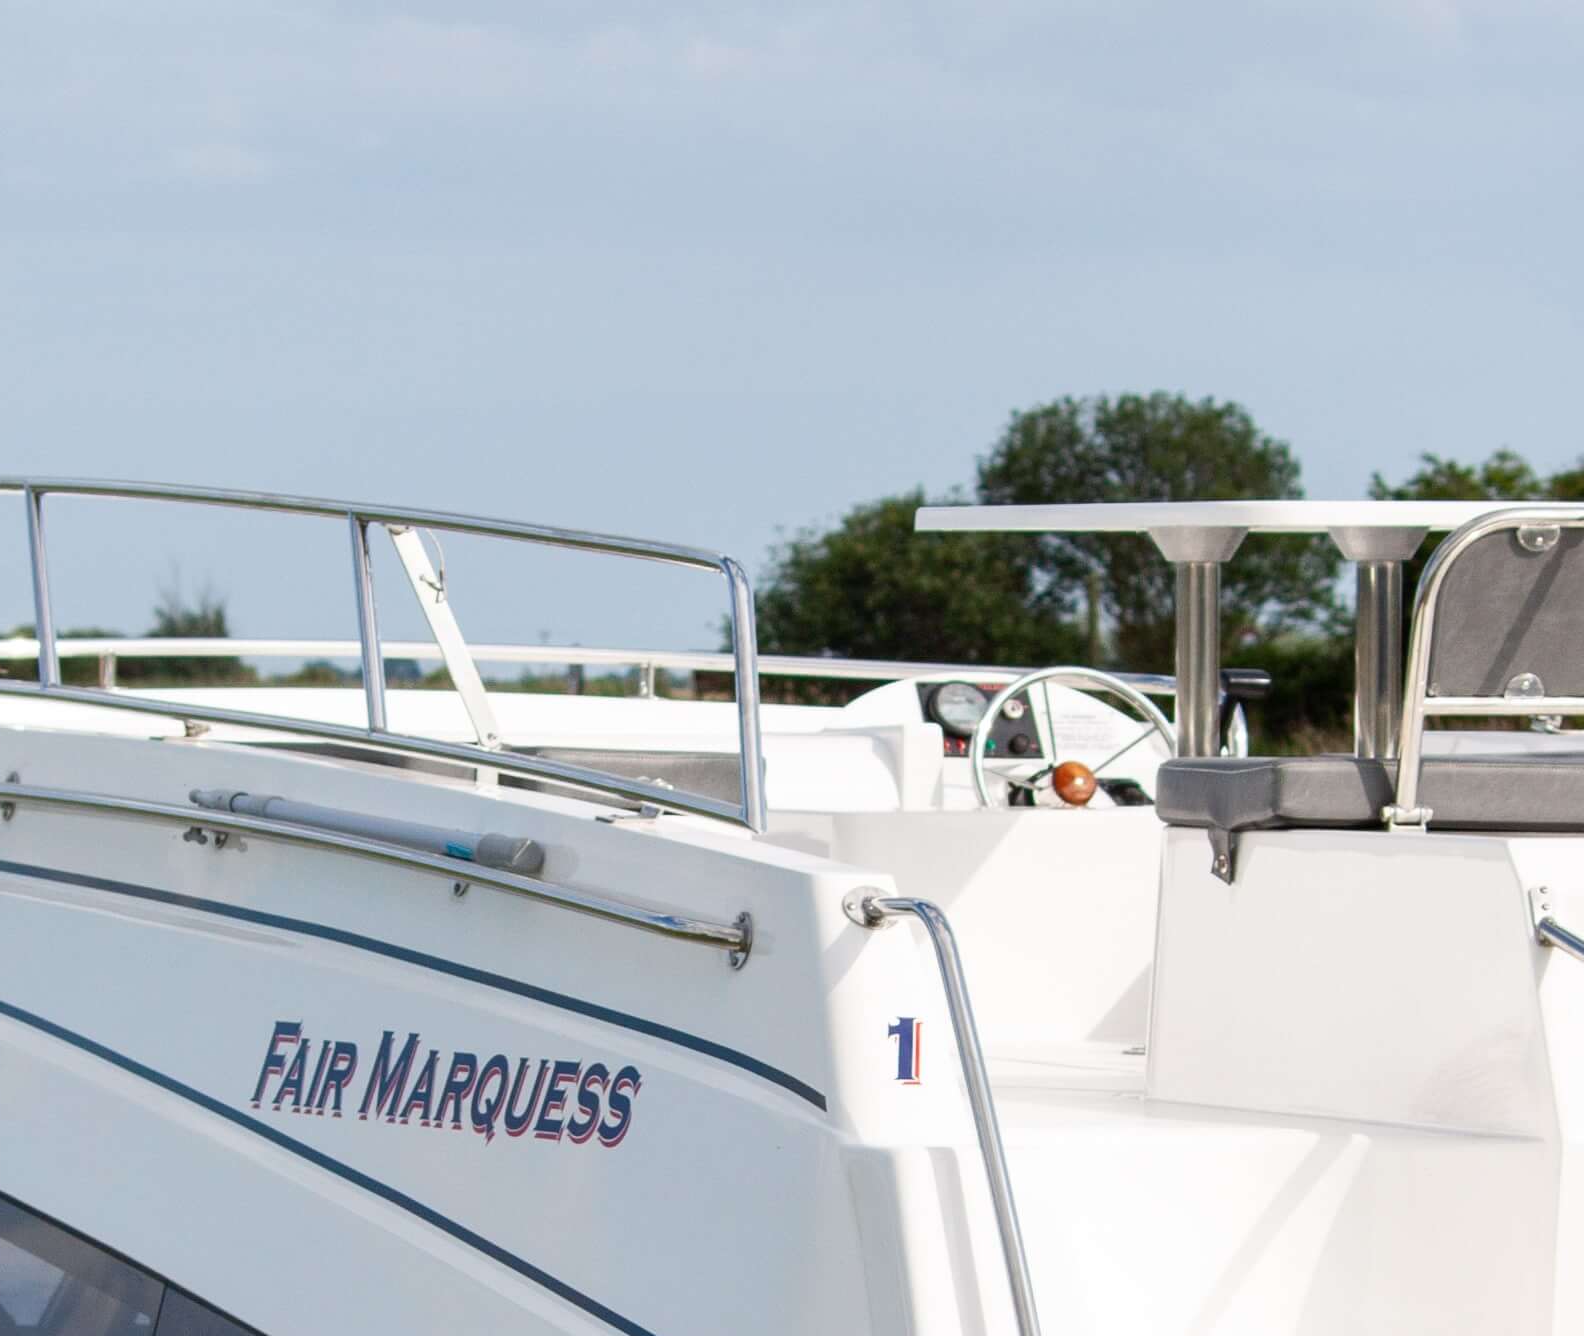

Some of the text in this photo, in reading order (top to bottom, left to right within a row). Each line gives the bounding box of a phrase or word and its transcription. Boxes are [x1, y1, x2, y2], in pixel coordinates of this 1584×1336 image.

[250, 1021, 643, 1147] FAIR MARQUESS
[887, 1016, 923, 1085] 1
